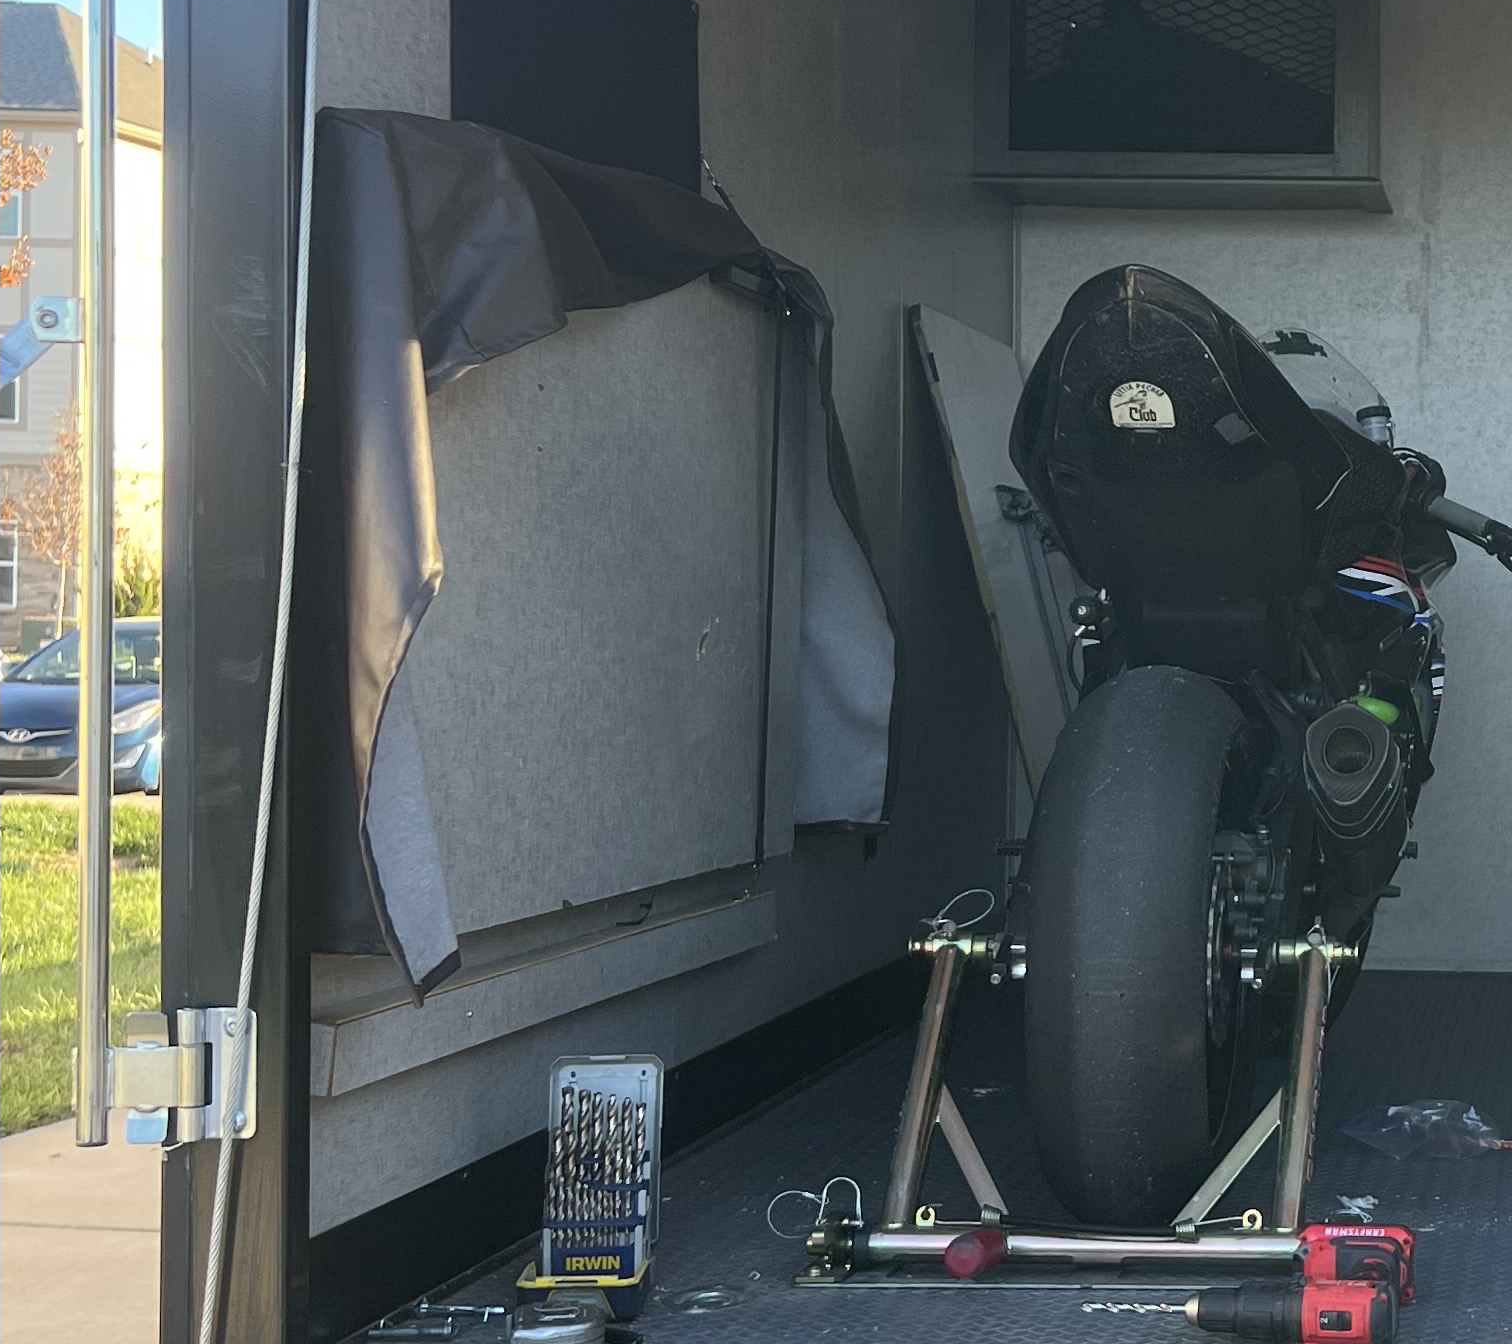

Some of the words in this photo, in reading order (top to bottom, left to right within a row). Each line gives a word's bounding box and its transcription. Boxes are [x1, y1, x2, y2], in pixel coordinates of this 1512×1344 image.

[1129, 407, 1157, 422] Club
[1324, 1227, 1386, 1238] CRAFTSMAN
[565, 1256, 621, 1272] IRWIN
